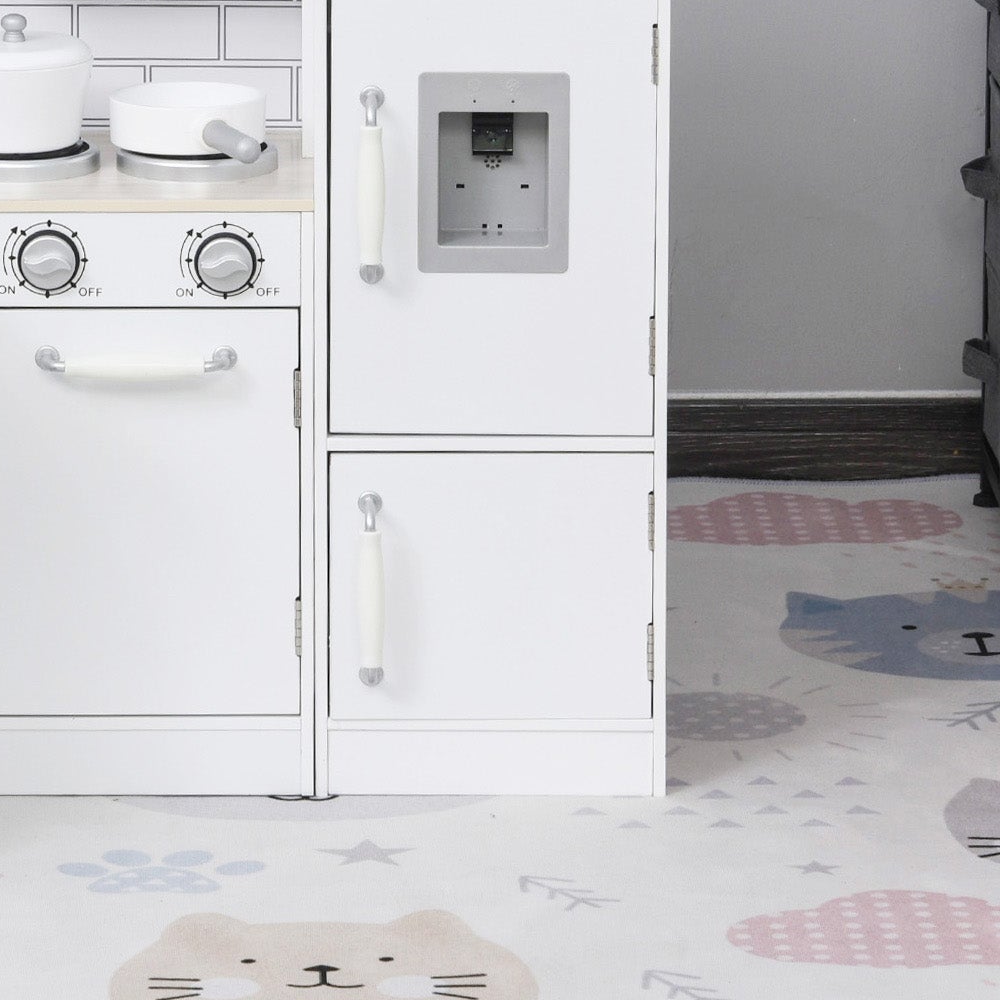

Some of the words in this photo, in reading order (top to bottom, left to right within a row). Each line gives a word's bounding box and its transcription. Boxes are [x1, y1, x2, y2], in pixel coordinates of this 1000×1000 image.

[78, 287, 102, 297] OFF
[175, 287, 194, 297] ON
[256, 287, 280, 297] OFF
